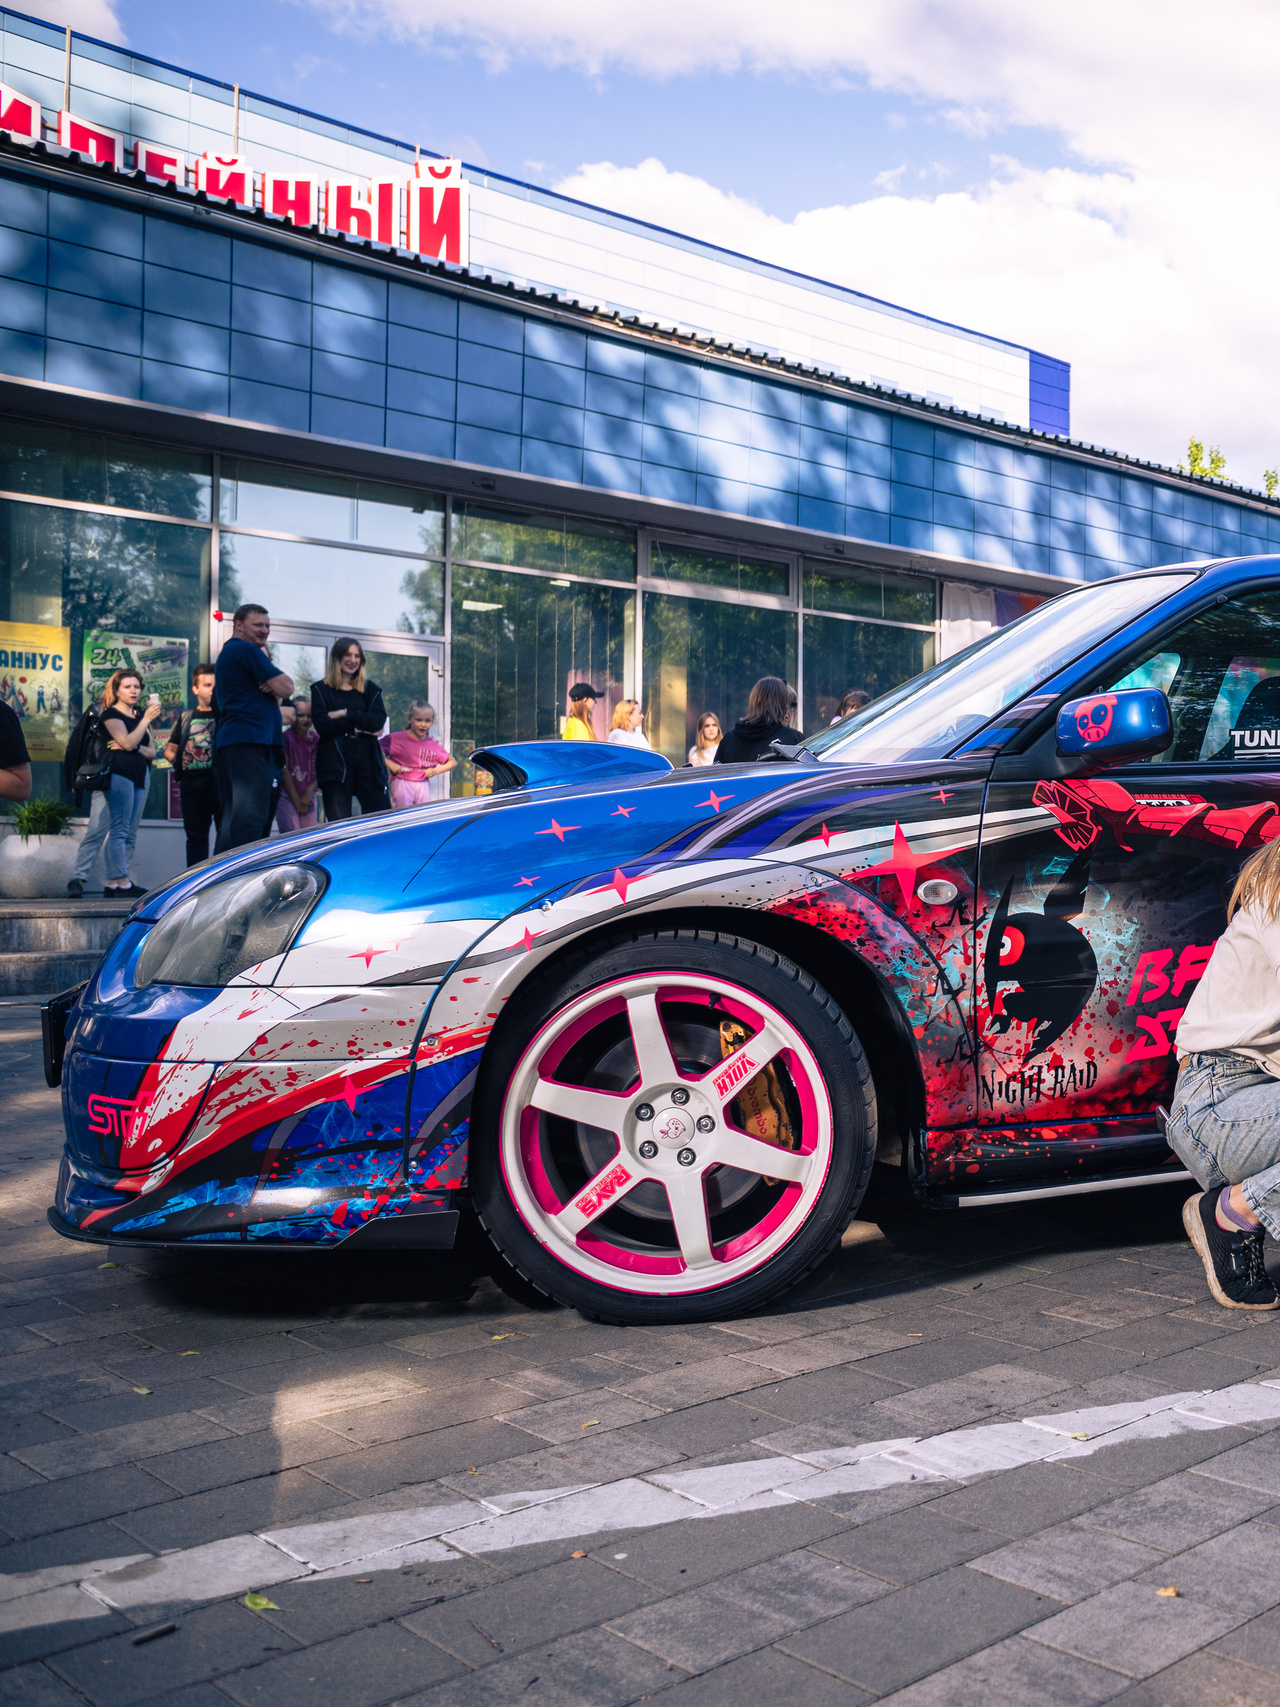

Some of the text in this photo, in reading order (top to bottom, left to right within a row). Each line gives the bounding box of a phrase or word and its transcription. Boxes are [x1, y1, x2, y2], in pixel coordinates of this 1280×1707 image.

[91, 646, 121, 668] 24
[714, 1055, 759, 1099] VOLK
[88, 1091, 156, 1140] STI
[747, 1086, 768, 1135] brembo
[580, 1167, 634, 1219] RAYS
